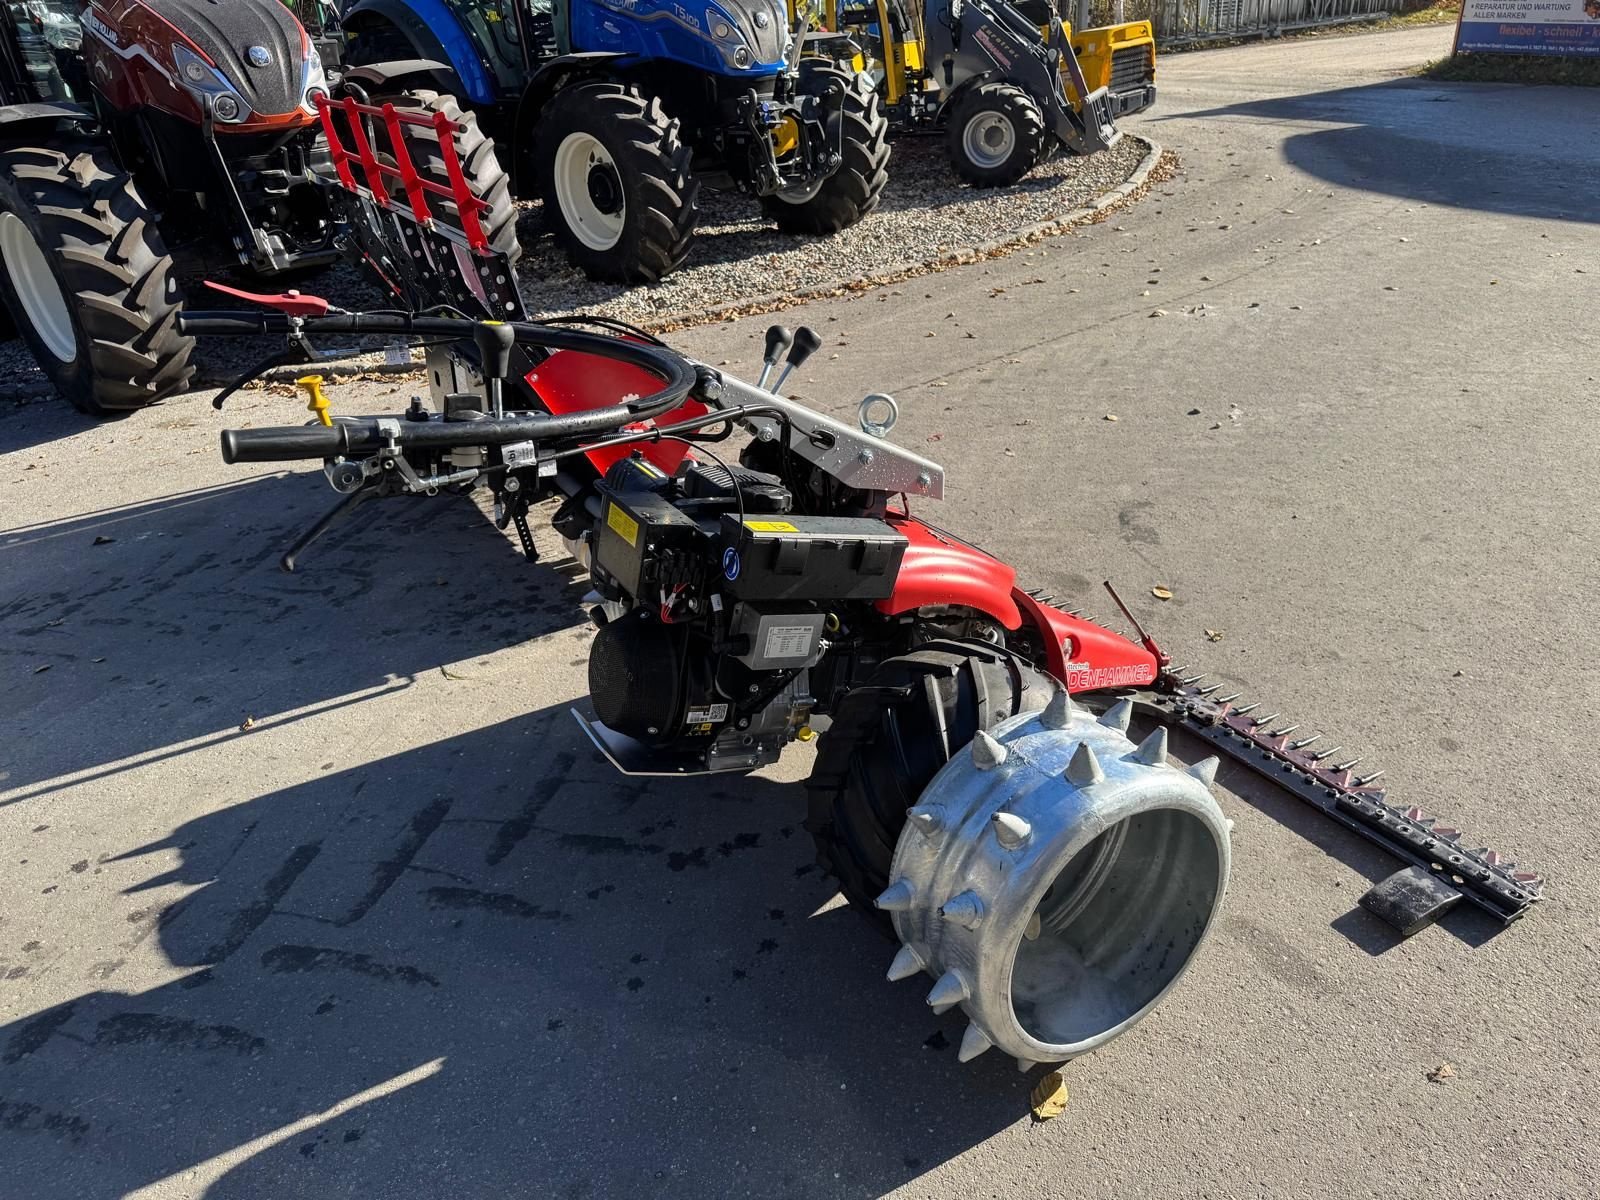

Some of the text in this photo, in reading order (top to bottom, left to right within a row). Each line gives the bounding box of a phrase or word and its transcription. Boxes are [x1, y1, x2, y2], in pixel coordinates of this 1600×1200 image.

[1499, 24, 1536, 36] flexibel
[1544, 26, 1583, 37] schnell
[1068, 663, 1151, 688] DENHAMMER
